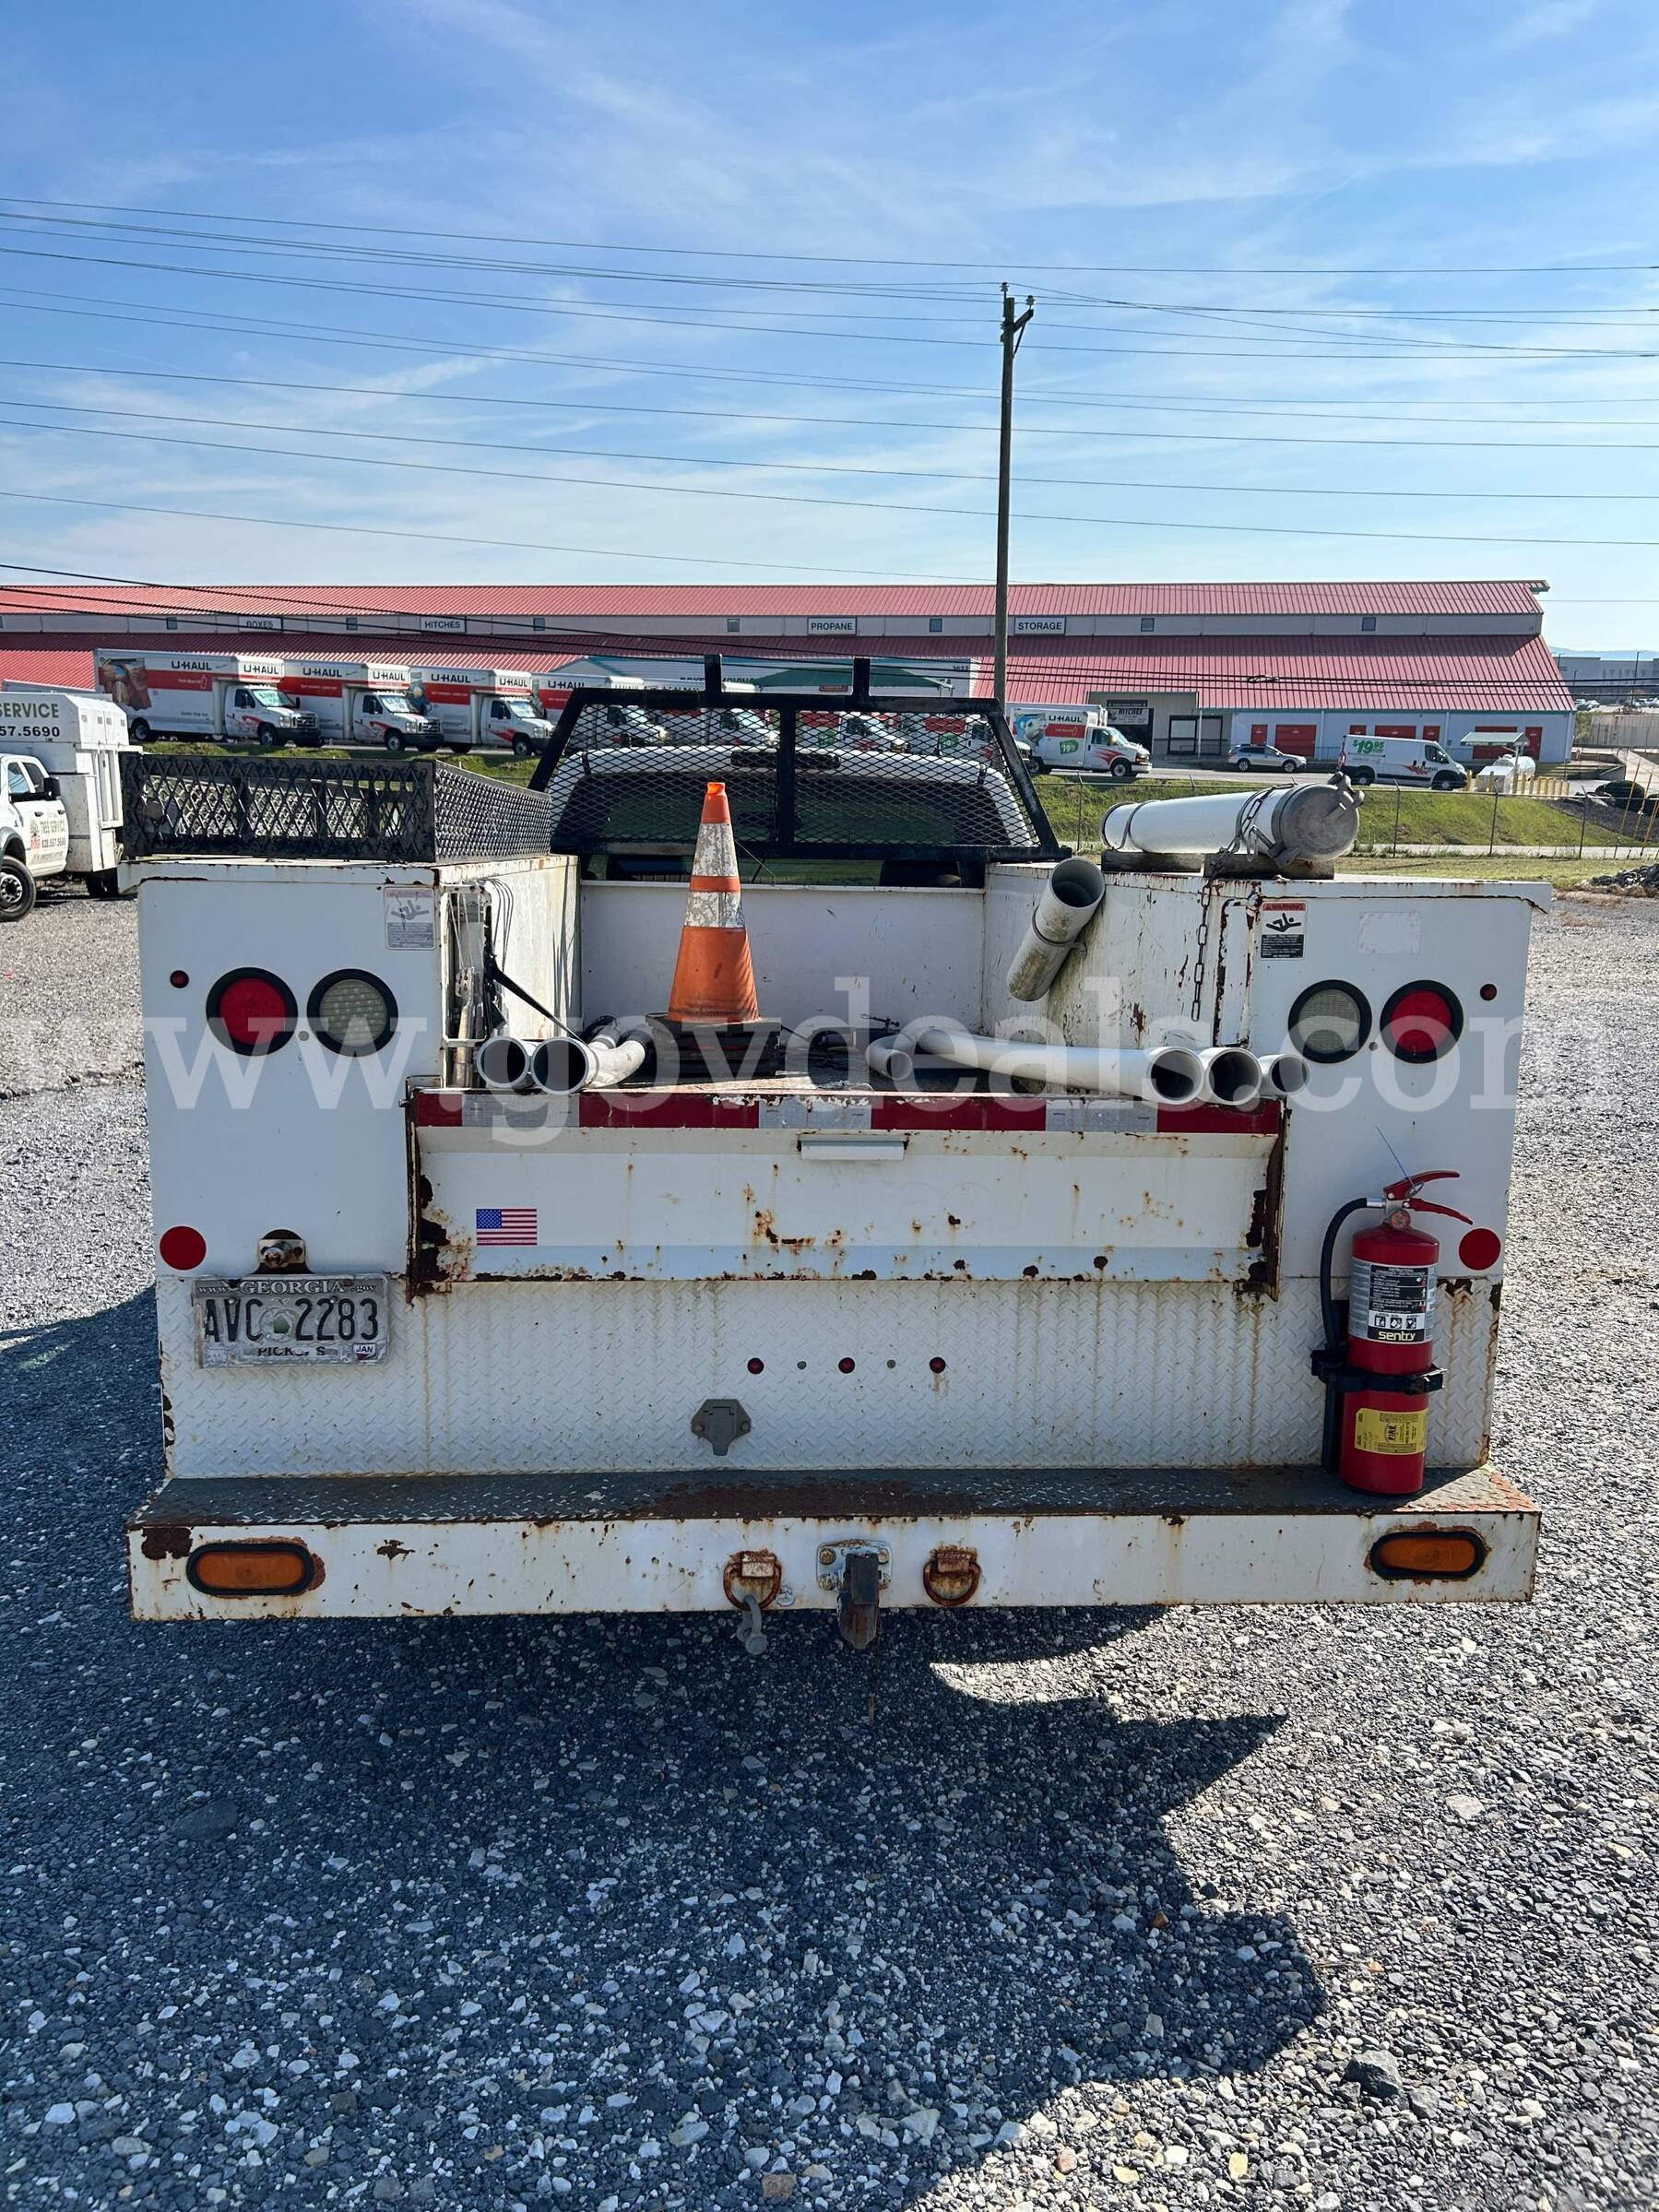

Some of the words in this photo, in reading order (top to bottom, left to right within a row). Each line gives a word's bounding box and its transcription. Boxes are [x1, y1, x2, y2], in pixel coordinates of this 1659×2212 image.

[245, 621, 274, 629] BOXES
[424, 621, 461, 629] HITCHES
[811, 621, 854, 631] PROPANE
[1017, 621, 1062, 631] STORAGE
[171, 660, 212, 671] U-HAUL
[243, 664, 278, 675] U-HAUL
[302, 668, 342, 678] U-HAUL
[373, 670, 406, 681] U-HAUL
[431, 673, 471, 683] U-HAUL
[499, 677, 528, 687] U-HAUL
[1049, 715, 1083, 723] U-HAUL
[240, 1280, 346, 1295] GEORGIA
[203, 1297, 264, 1343] AVC
[294, 1297, 379, 1342] 2283
[1377, 1331, 1416, 1342] sentry
[355, 1345, 373, 1354] JAN
